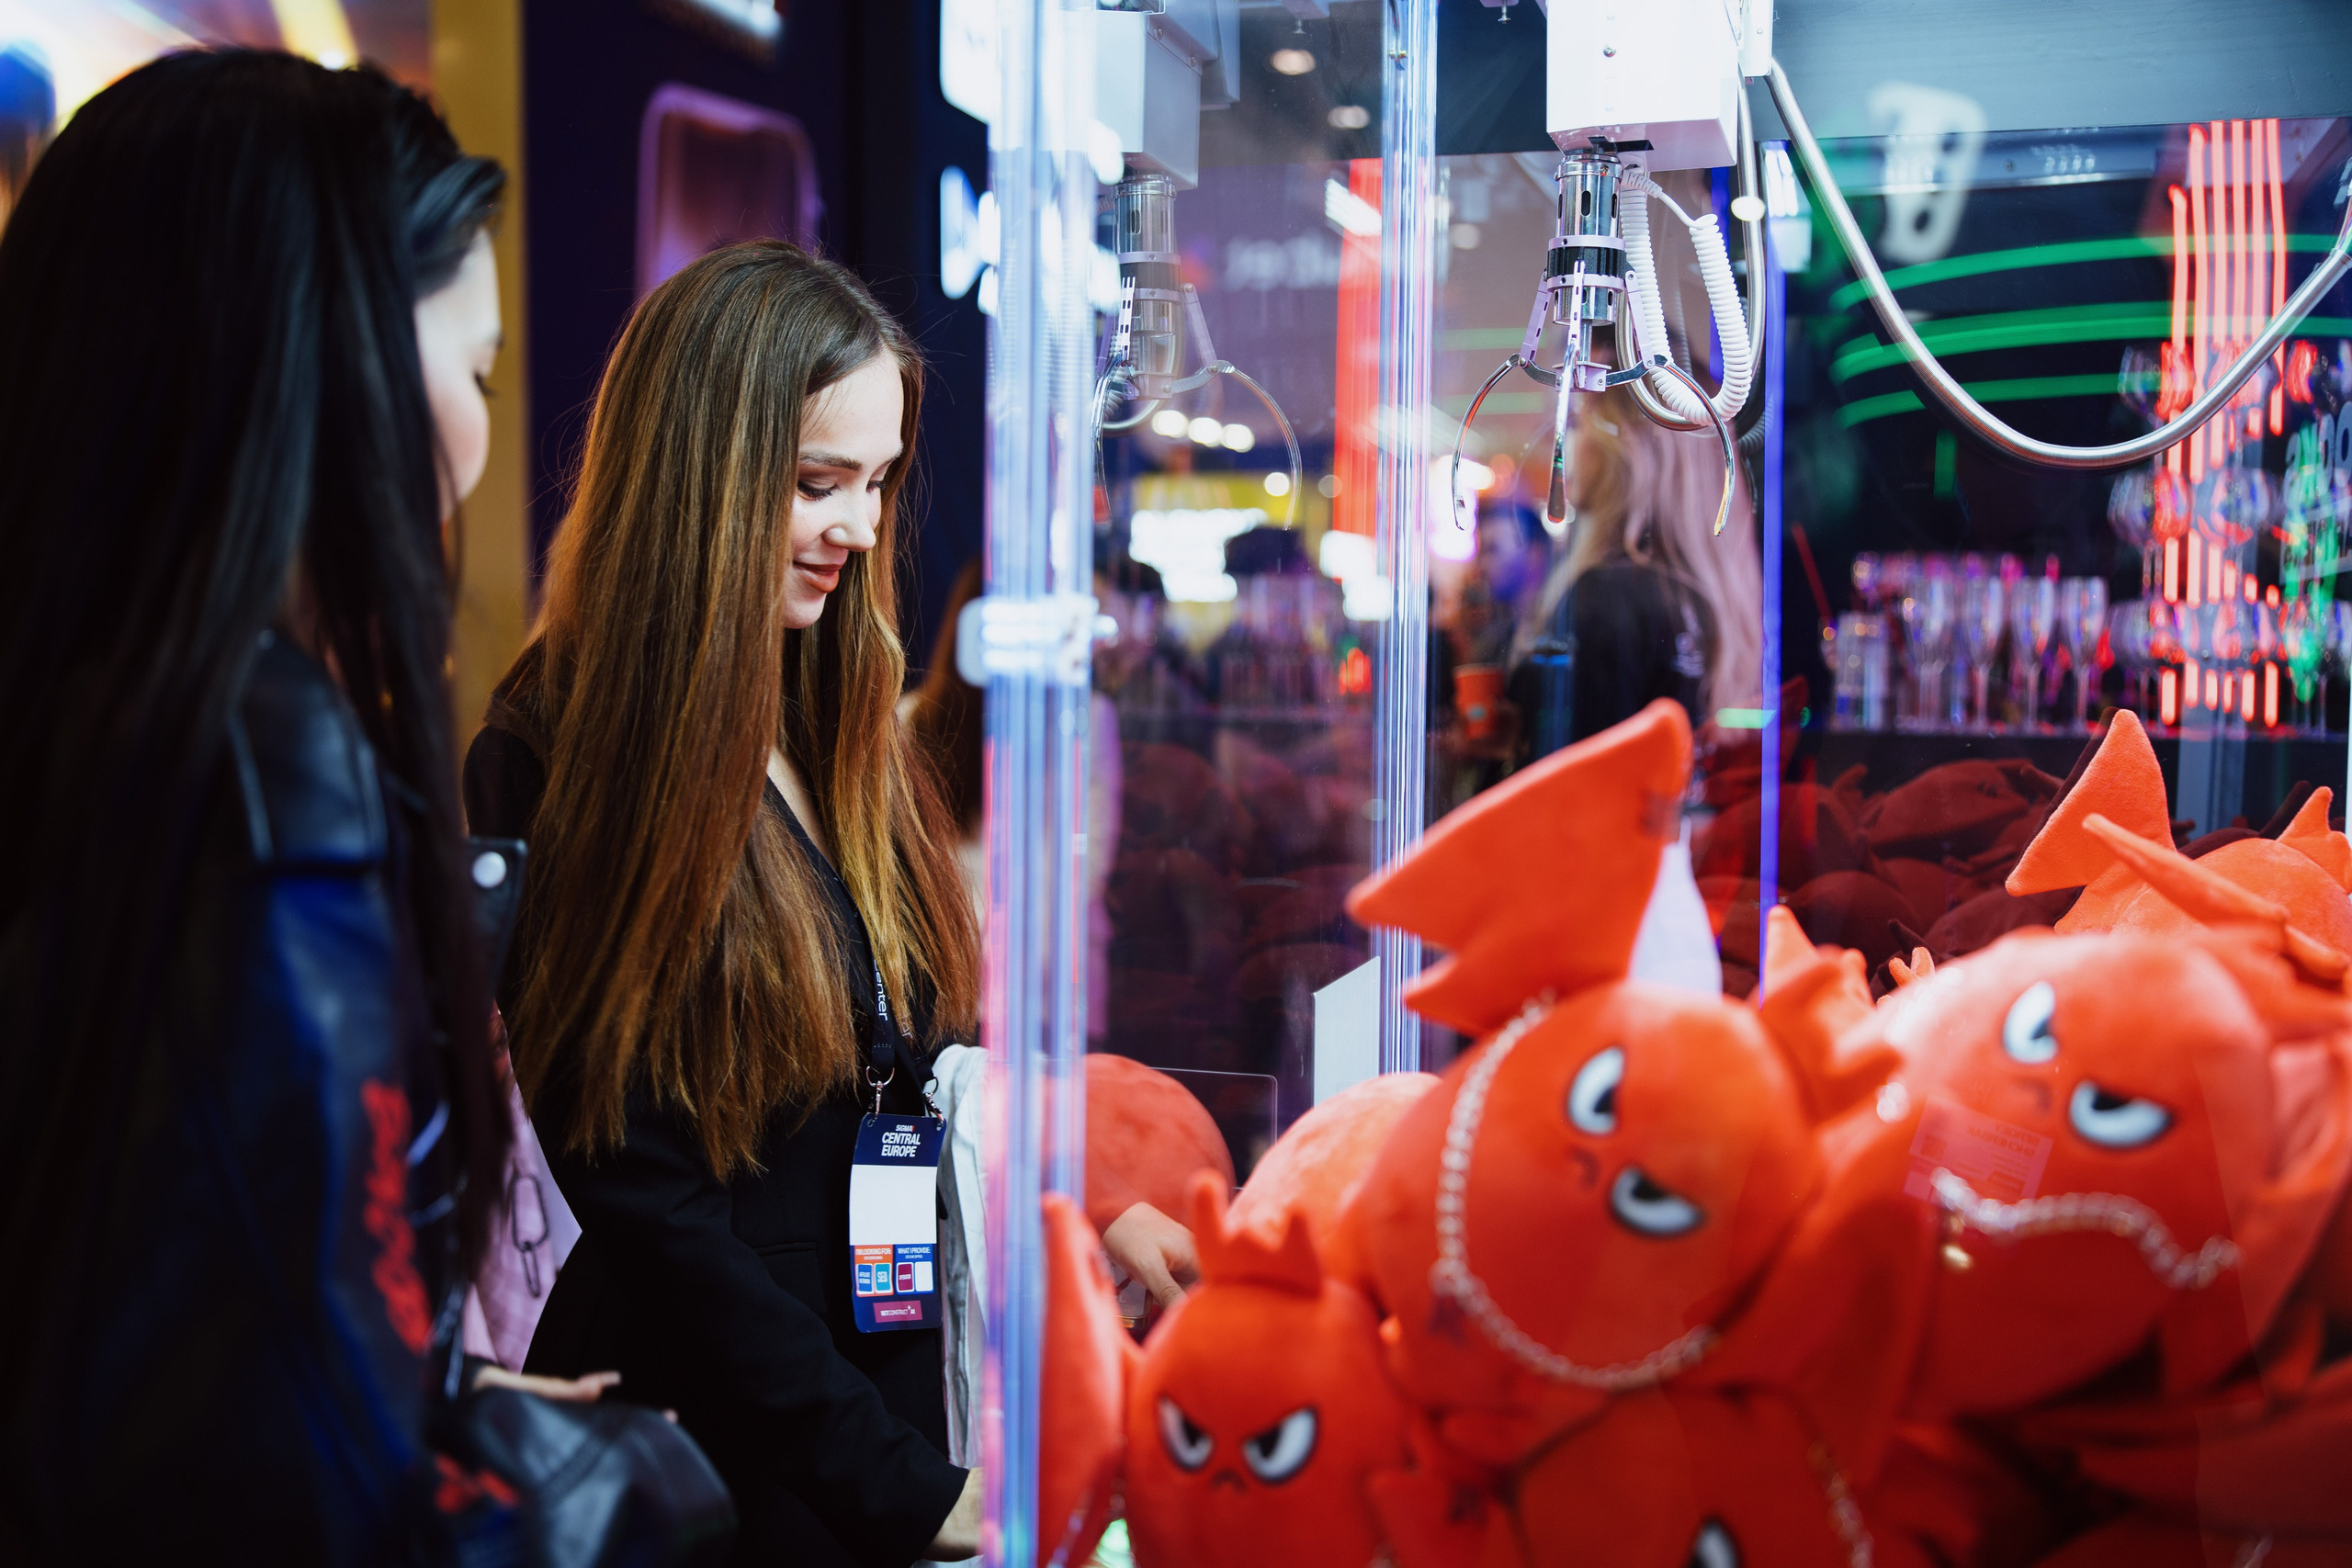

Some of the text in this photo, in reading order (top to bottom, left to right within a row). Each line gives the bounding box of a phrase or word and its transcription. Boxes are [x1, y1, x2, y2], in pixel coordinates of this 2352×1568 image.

[874, 959, 888, 1021] enter
[881, 1132, 922, 1145] CENTRAL
[881, 1145, 918, 1157] EUROPE
